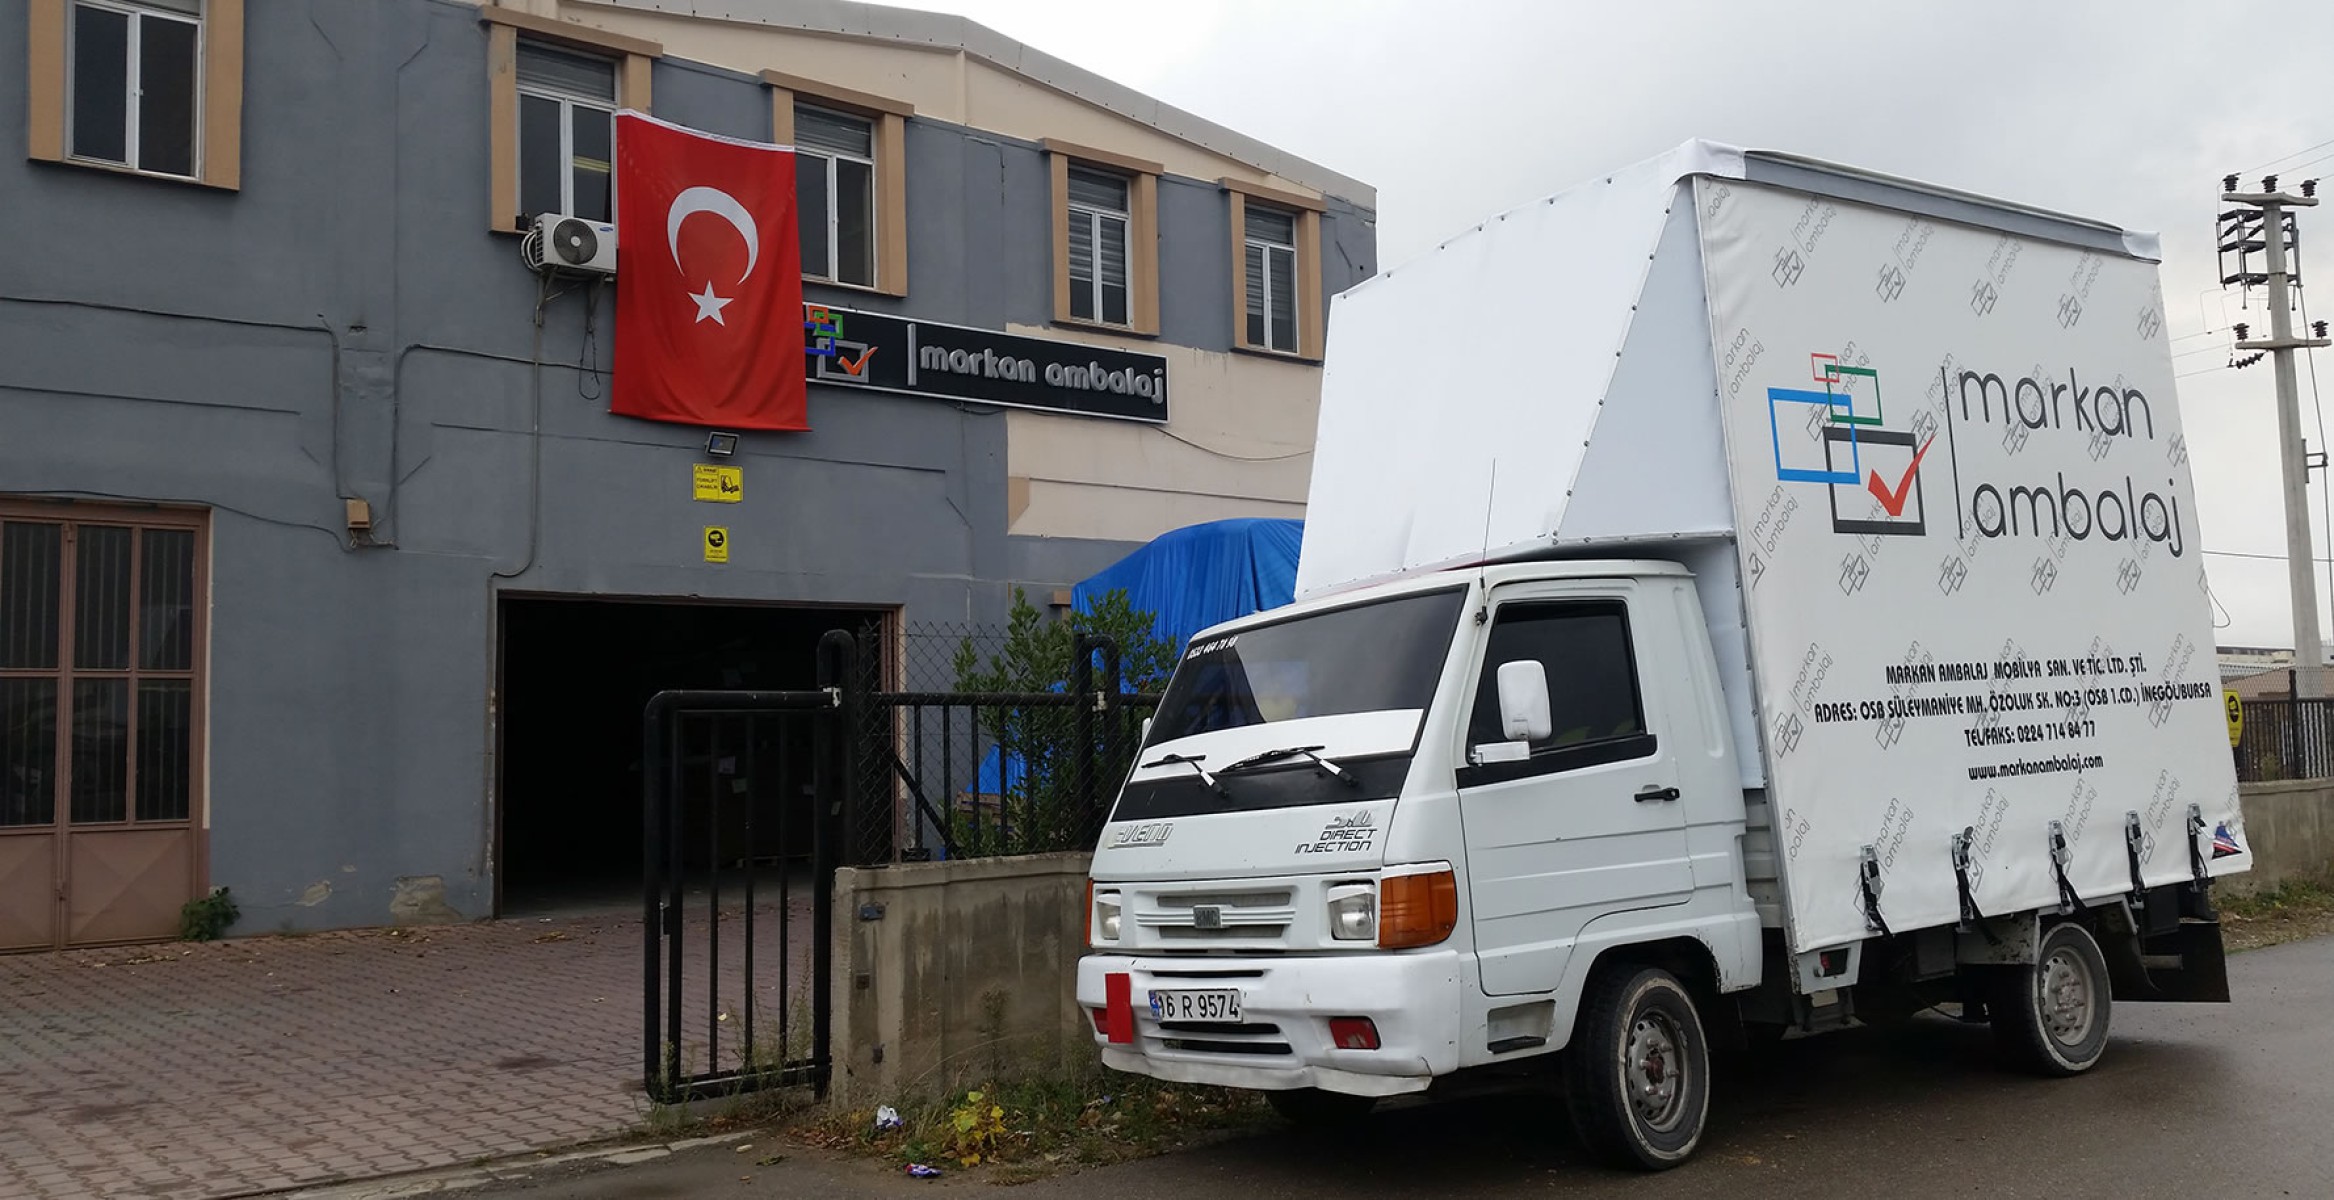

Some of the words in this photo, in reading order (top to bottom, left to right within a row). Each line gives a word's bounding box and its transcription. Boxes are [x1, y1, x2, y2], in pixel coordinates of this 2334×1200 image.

[920, 345, 1037, 383] markan
[1045, 360, 1164, 404] ambalaj
[1958, 367, 2154, 440] markan
[1972, 471, 2183, 558] ambalaj
[1885, 664, 1936, 685] MARKAN
[1938, 662, 1989, 682] AMBALAJ
[1993, 657, 2042, 680] MOBİLYA
[2046, 659, 2071, 677] SAN.
[2072, 658, 2086, 676] VE
[2106, 657, 2128, 674] LTD.
[2129, 652, 2147, 677] ŞTİ.
[1814, 700, 1858, 723] ADRES:
[1859, 701, 1886, 720] OSB
[1887, 692, 1965, 719] SÜLEYMANİYE
[1966, 695, 1988, 714] MH.
[1989, 690, 2035, 712] ÖZOLUK
[2035, 691, 2054, 709] SK.
[2083, 687, 2109, 707] (OSB
[2017, 723, 2045, 743] 0224
[2045, 721, 2066, 741] 714
[2067, 721, 2082, 739] 84
[2082, 719, 2096, 738] 77
[1967, 752, 2104, 781] www.markanambalaj.com
[1294, 840, 1373, 854] INJECTION
[1319, 829, 1378, 841] DIRECT
[1182, 994, 1194, 1018] R
[1198, 994, 1240, 1018] 9574
